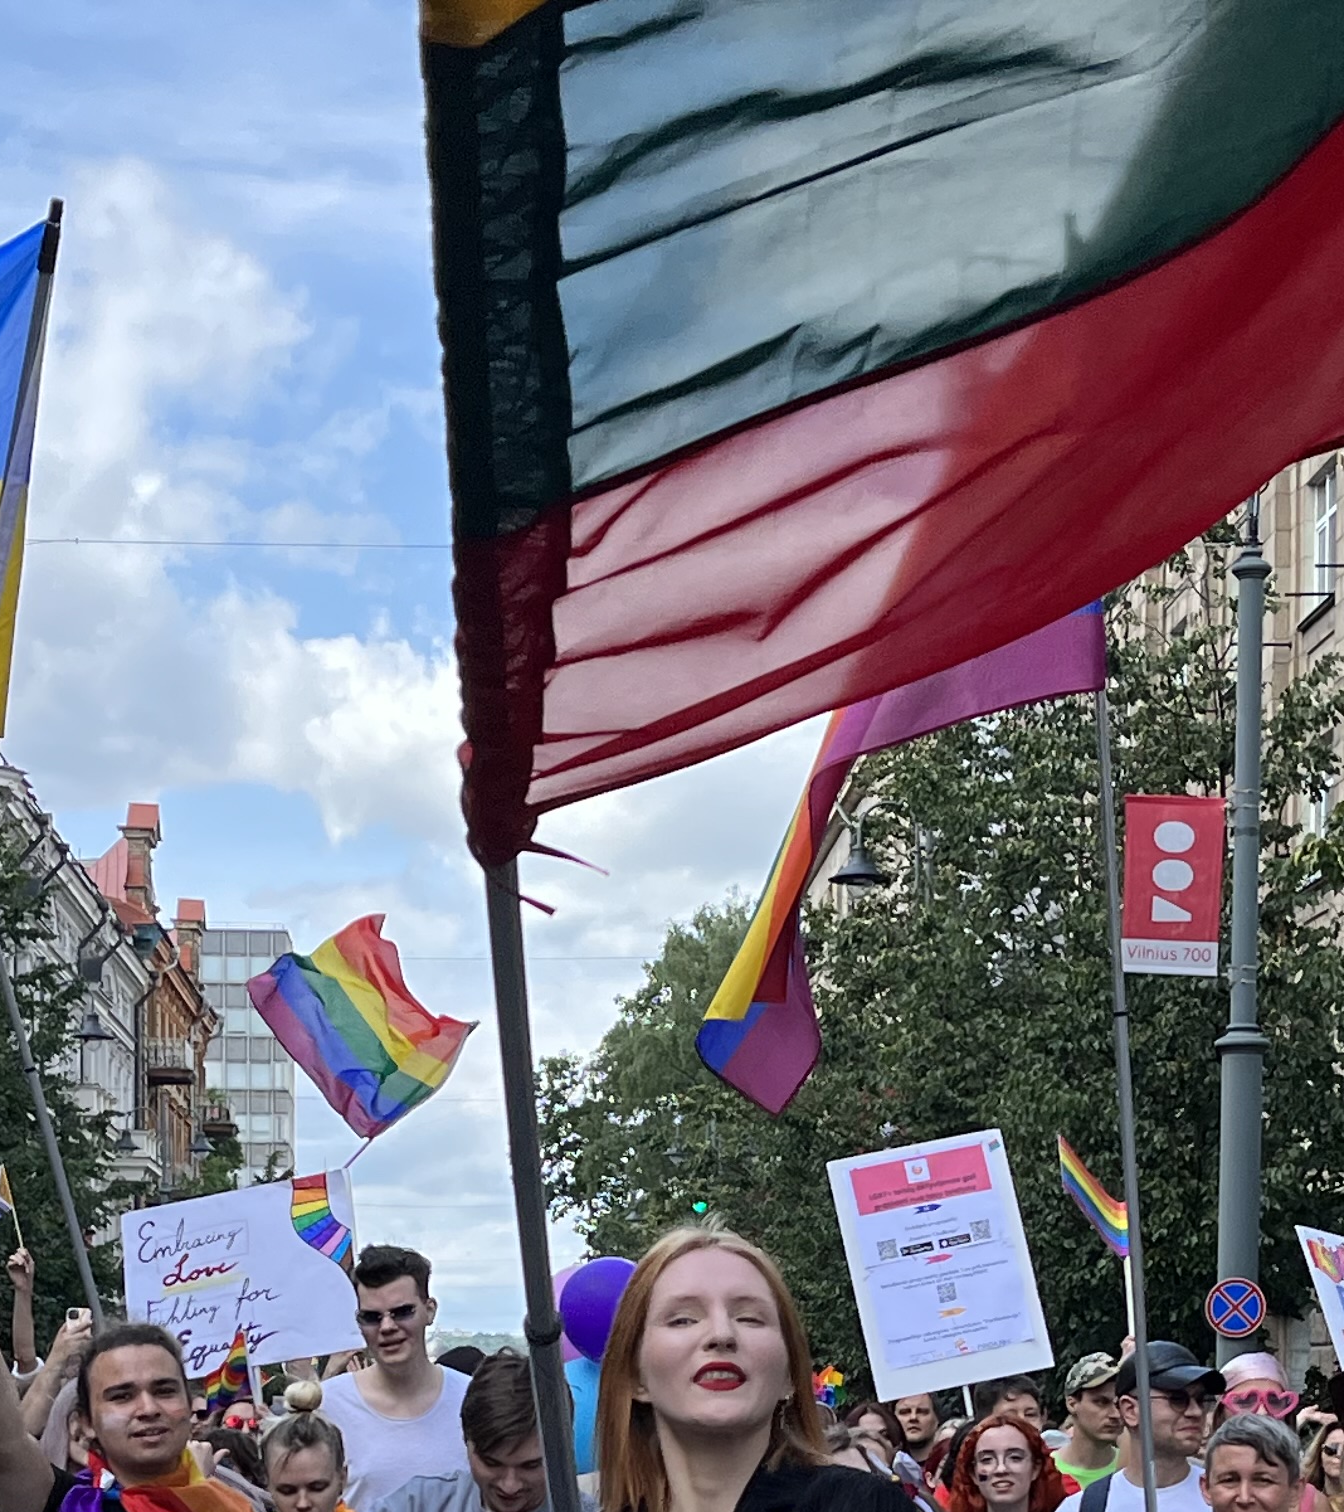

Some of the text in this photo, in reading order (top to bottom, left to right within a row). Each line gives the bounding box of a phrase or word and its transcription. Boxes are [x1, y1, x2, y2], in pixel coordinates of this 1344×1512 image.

[1127, 945, 1212, 962] Vilnius 700
[138, 1218, 243, 1263] Embracing
[163, 1253, 239, 1287] Love
[236, 1278, 282, 1320] for
